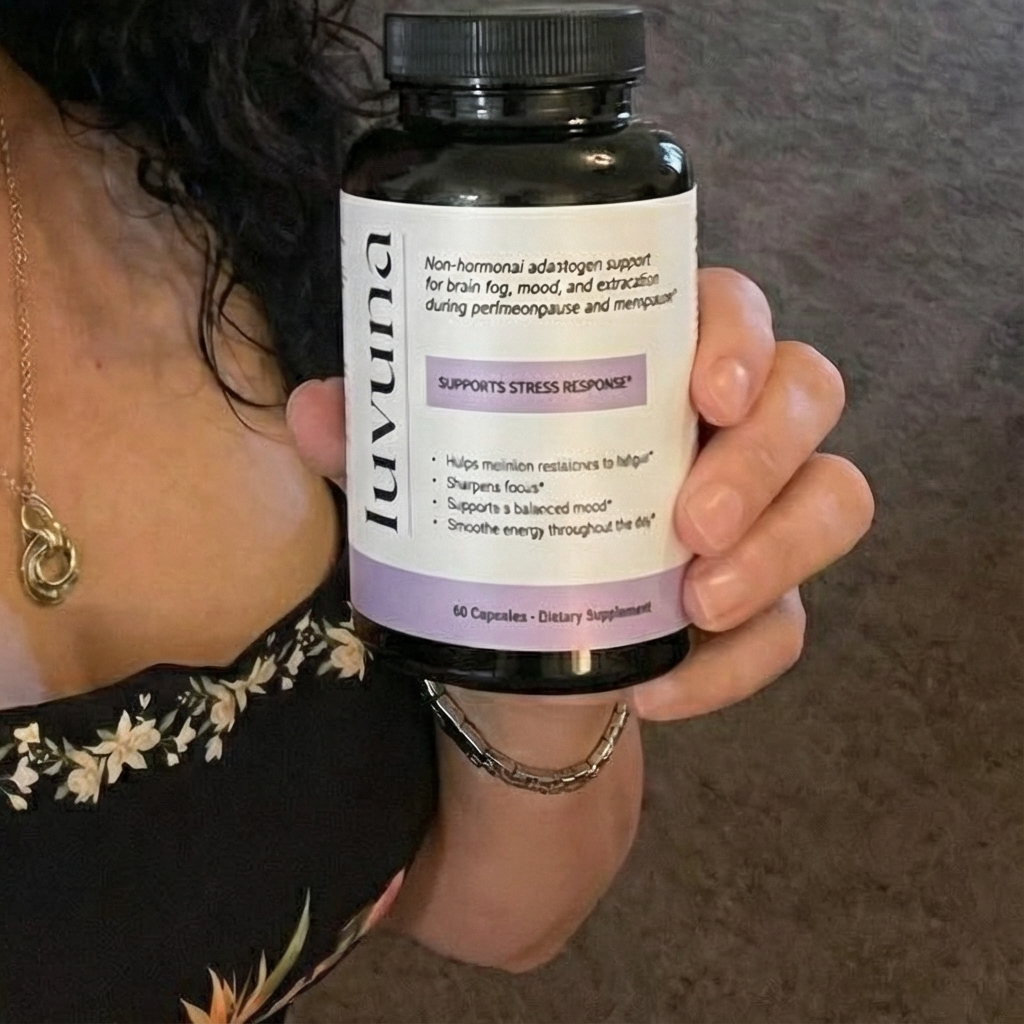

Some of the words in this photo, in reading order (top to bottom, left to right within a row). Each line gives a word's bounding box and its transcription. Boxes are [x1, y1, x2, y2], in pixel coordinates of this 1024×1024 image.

[606, 252, 652, 273] support
[425, 275, 444, 291] for
[446, 277, 481, 294] brain
[485, 279, 513, 299] fog,
[517, 279, 563, 297] mood,
[566, 277, 594, 294] and
[425, 297, 468, 318] during
[584, 296, 611, 314] and
[365, 231, 399, 534] luvuna
[438, 376, 507, 394] SUPPORTS
[509, 380, 560, 394] STRESS
[453, 604, 468, 618] 60
